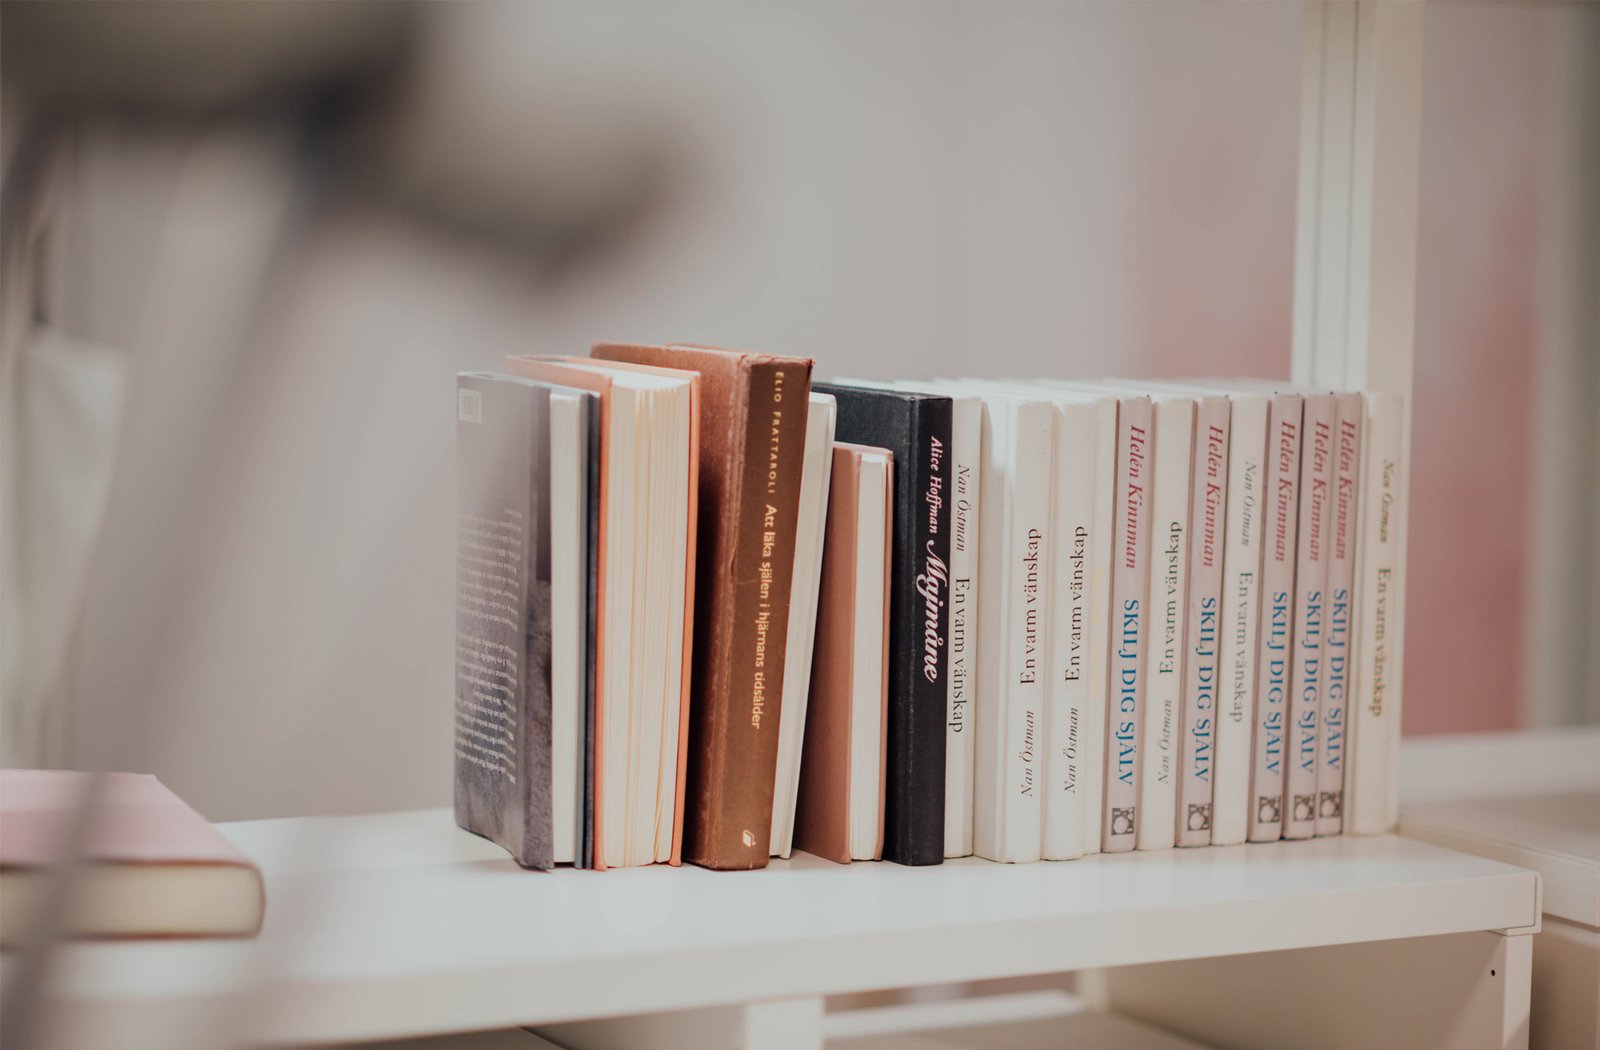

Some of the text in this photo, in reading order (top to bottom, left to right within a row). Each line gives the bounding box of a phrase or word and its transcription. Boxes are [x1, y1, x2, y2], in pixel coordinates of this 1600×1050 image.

[773, 371, 784, 403] ELIO
[768, 411, 782, 494] FRATTAROLI
[1313, 420, 1330, 473] Helén
[1339, 420, 1356, 472] Helén
[1245, 461, 1257, 490] Nan
[762, 531, 776, 558] läka
[764, 504, 778, 528] Att
[1309, 477, 1327, 562] Kinnman
[1335, 476, 1354, 560] Kinnman
[758, 562, 773, 599] själen
[916, 436, 948, 684] Alice Hoffman Majmåne
[1238, 572, 1254, 597] En
[1377, 568, 1392, 594] En
[948, 464, 972, 733] Nan Östman En varm vänskap
[1116, 425, 1146, 786] Helén Kinnman SKILJ DIG SJÄLV
[1192, 425, 1224, 783] Helén Kinnman SKILJ DIG SJÄLV
[1236, 600, 1248, 646] varm
[1263, 420, 1296, 775] Helén Kinnman SKILJ DIG SJÄLV
[1301, 591, 1322, 649] SKILJ
[1328, 588, 1348, 648] SKILJ
[754, 612, 771, 668] hjärnans
[1019, 528, 1042, 798] Nan Östman En varm vänskap
[1063, 526, 1088, 794] Nan Östman En varm vänskap
[1157, 521, 1183, 784] Nan Östman En varm vänskap
[752, 672, 766, 730] tidsålder
[1229, 649, 1247, 723] vänskap
[1302, 659, 1319, 702] DIG
[1328, 656, 1346, 700] DIG
